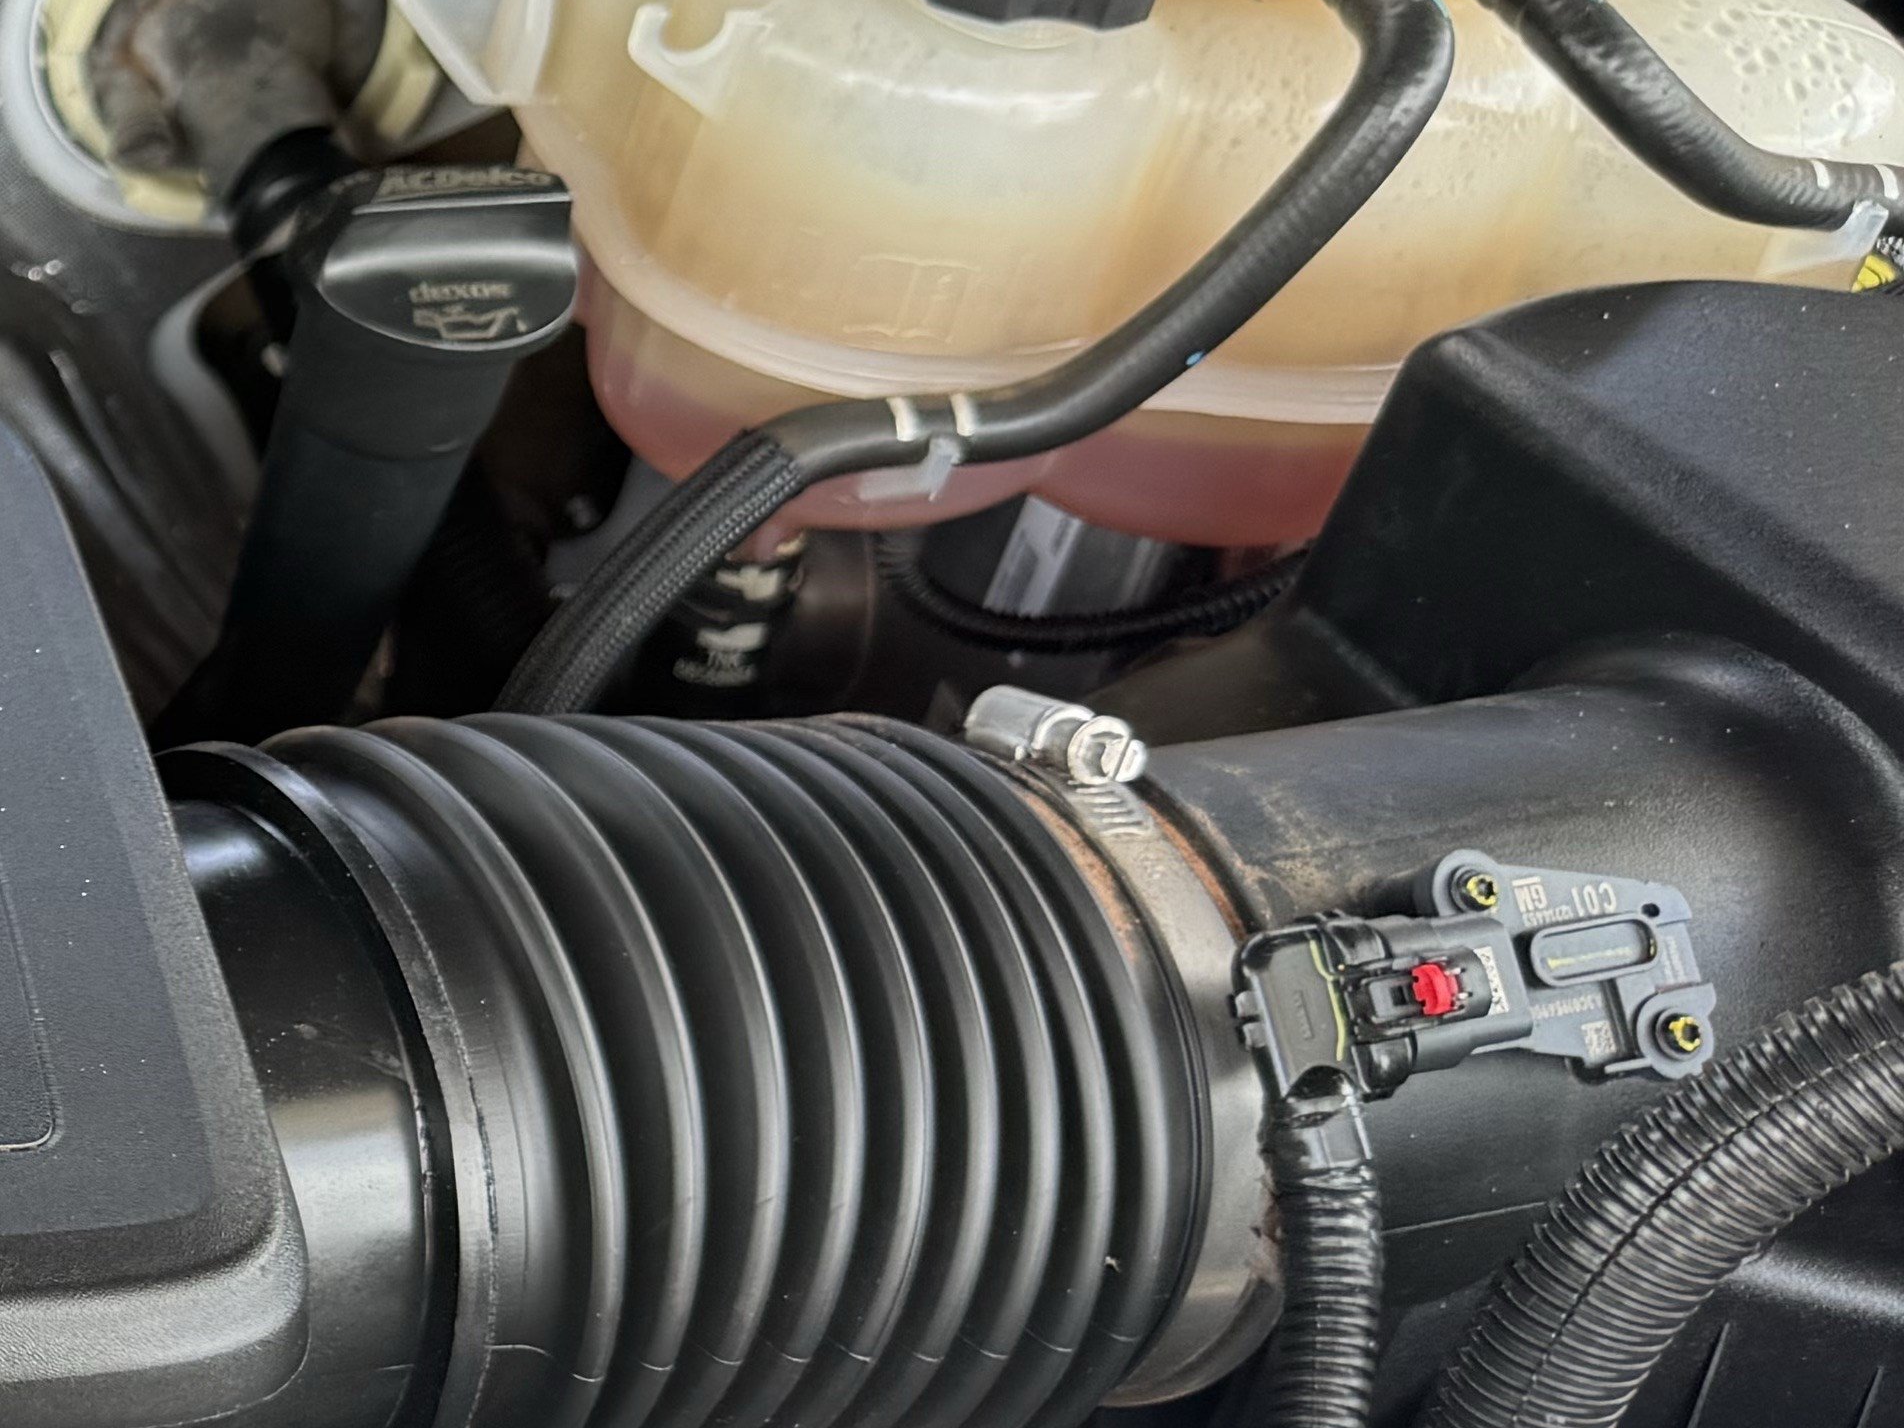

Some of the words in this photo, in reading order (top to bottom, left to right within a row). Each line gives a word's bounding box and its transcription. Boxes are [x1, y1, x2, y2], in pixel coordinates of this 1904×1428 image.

[373, 166, 553, 202] ACDelco
[1513, 883, 1548, 913] GM
[1571, 882, 1617, 917] C01
